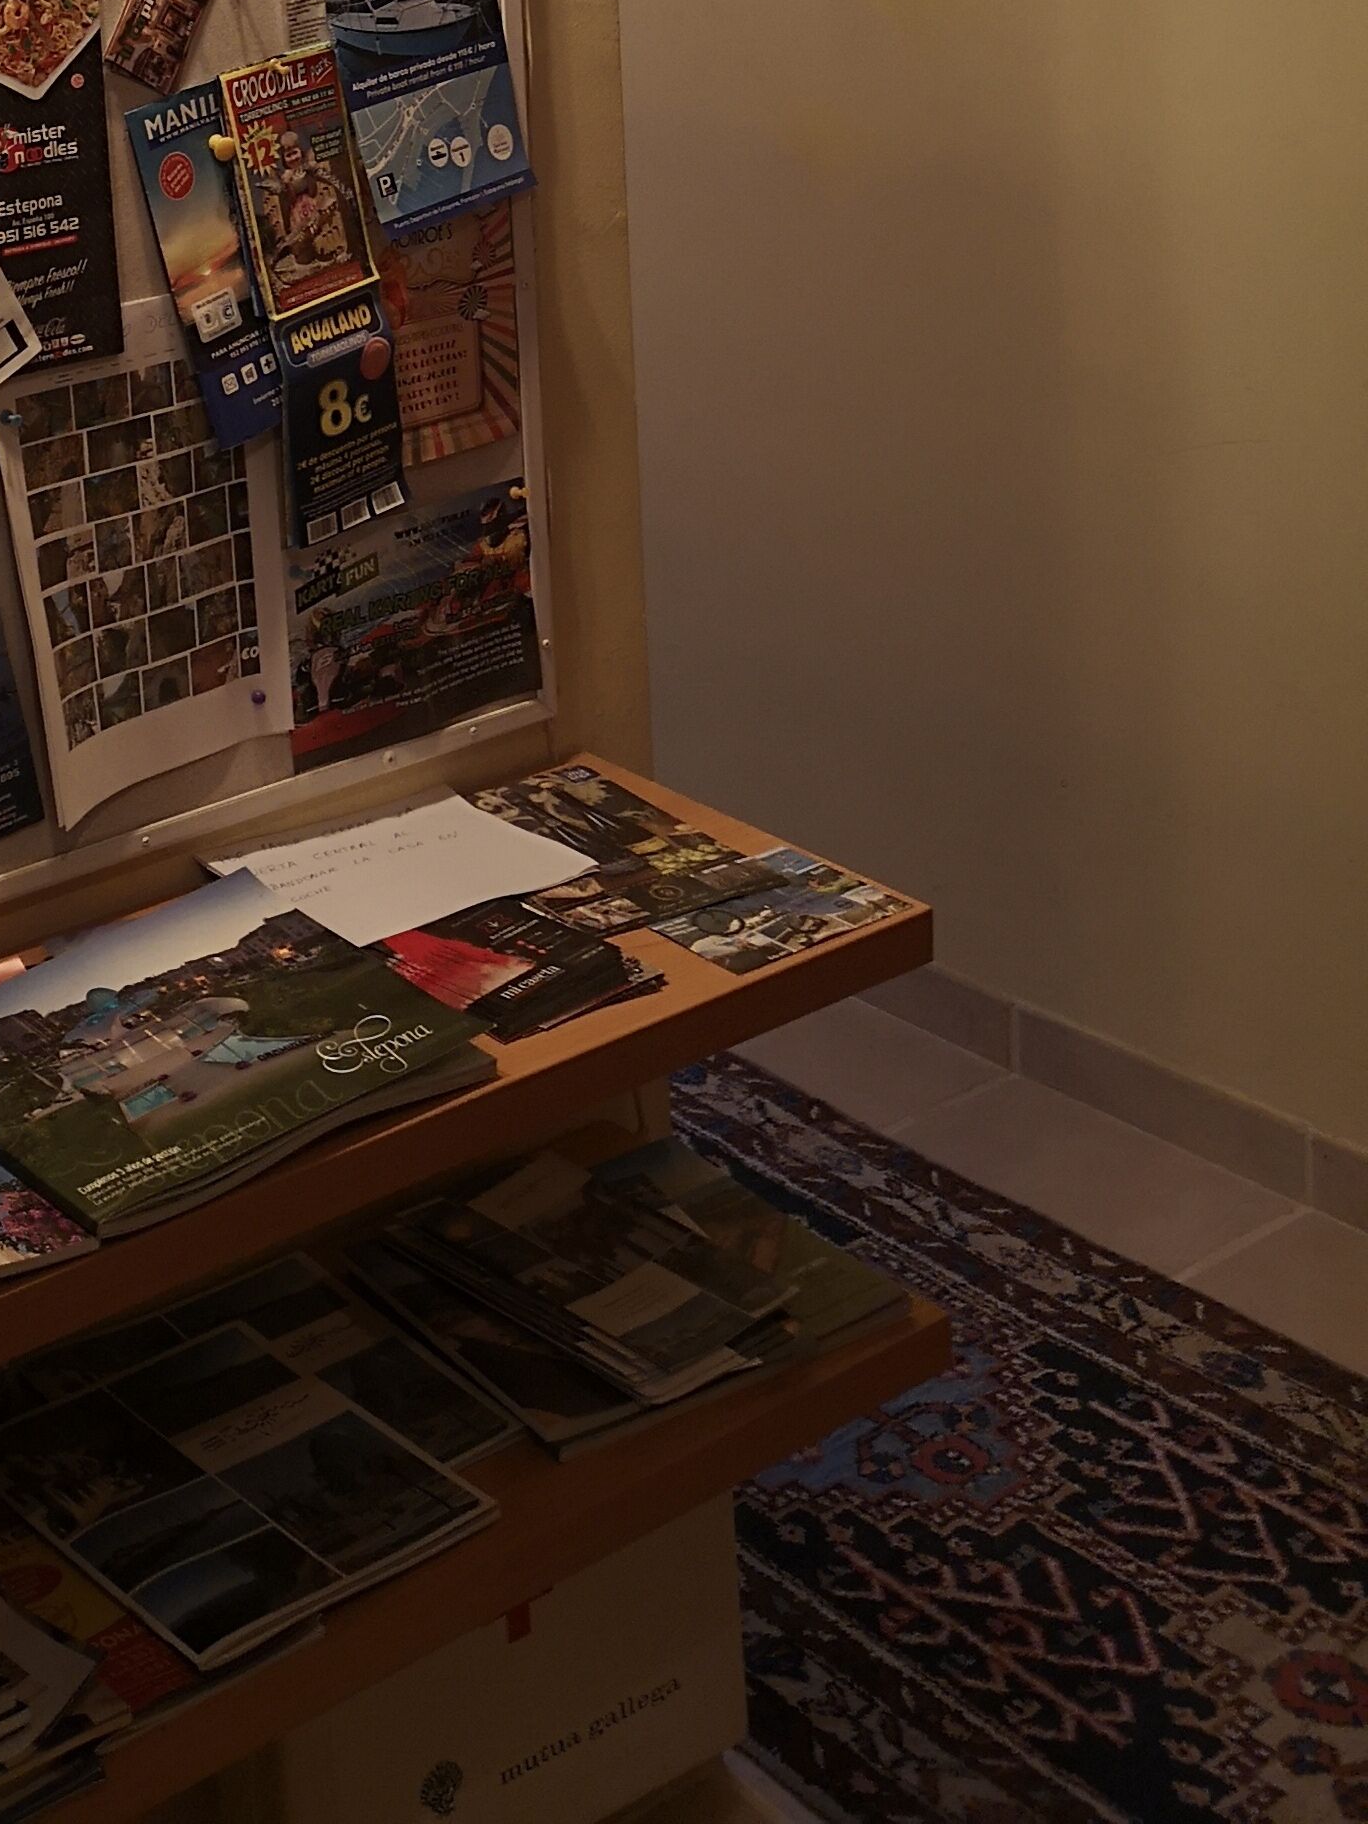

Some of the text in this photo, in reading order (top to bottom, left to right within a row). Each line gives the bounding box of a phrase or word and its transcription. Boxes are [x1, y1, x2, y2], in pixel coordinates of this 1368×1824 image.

[231, 61, 308, 109] CROCODILE
[13, 124, 66, 145] mister
[143, 93, 221, 141] MANIL
[14, 140, 79, 166] noodles
[23, 222, 47, 240] 516
[49, 217, 81, 236] 542
[291, 302, 373, 356] AQUALAND
[344, 557, 376, 587] FUN
[315, 1013, 435, 1074] Estepona
[497, 1676, 684, 1787] mutua gallega
